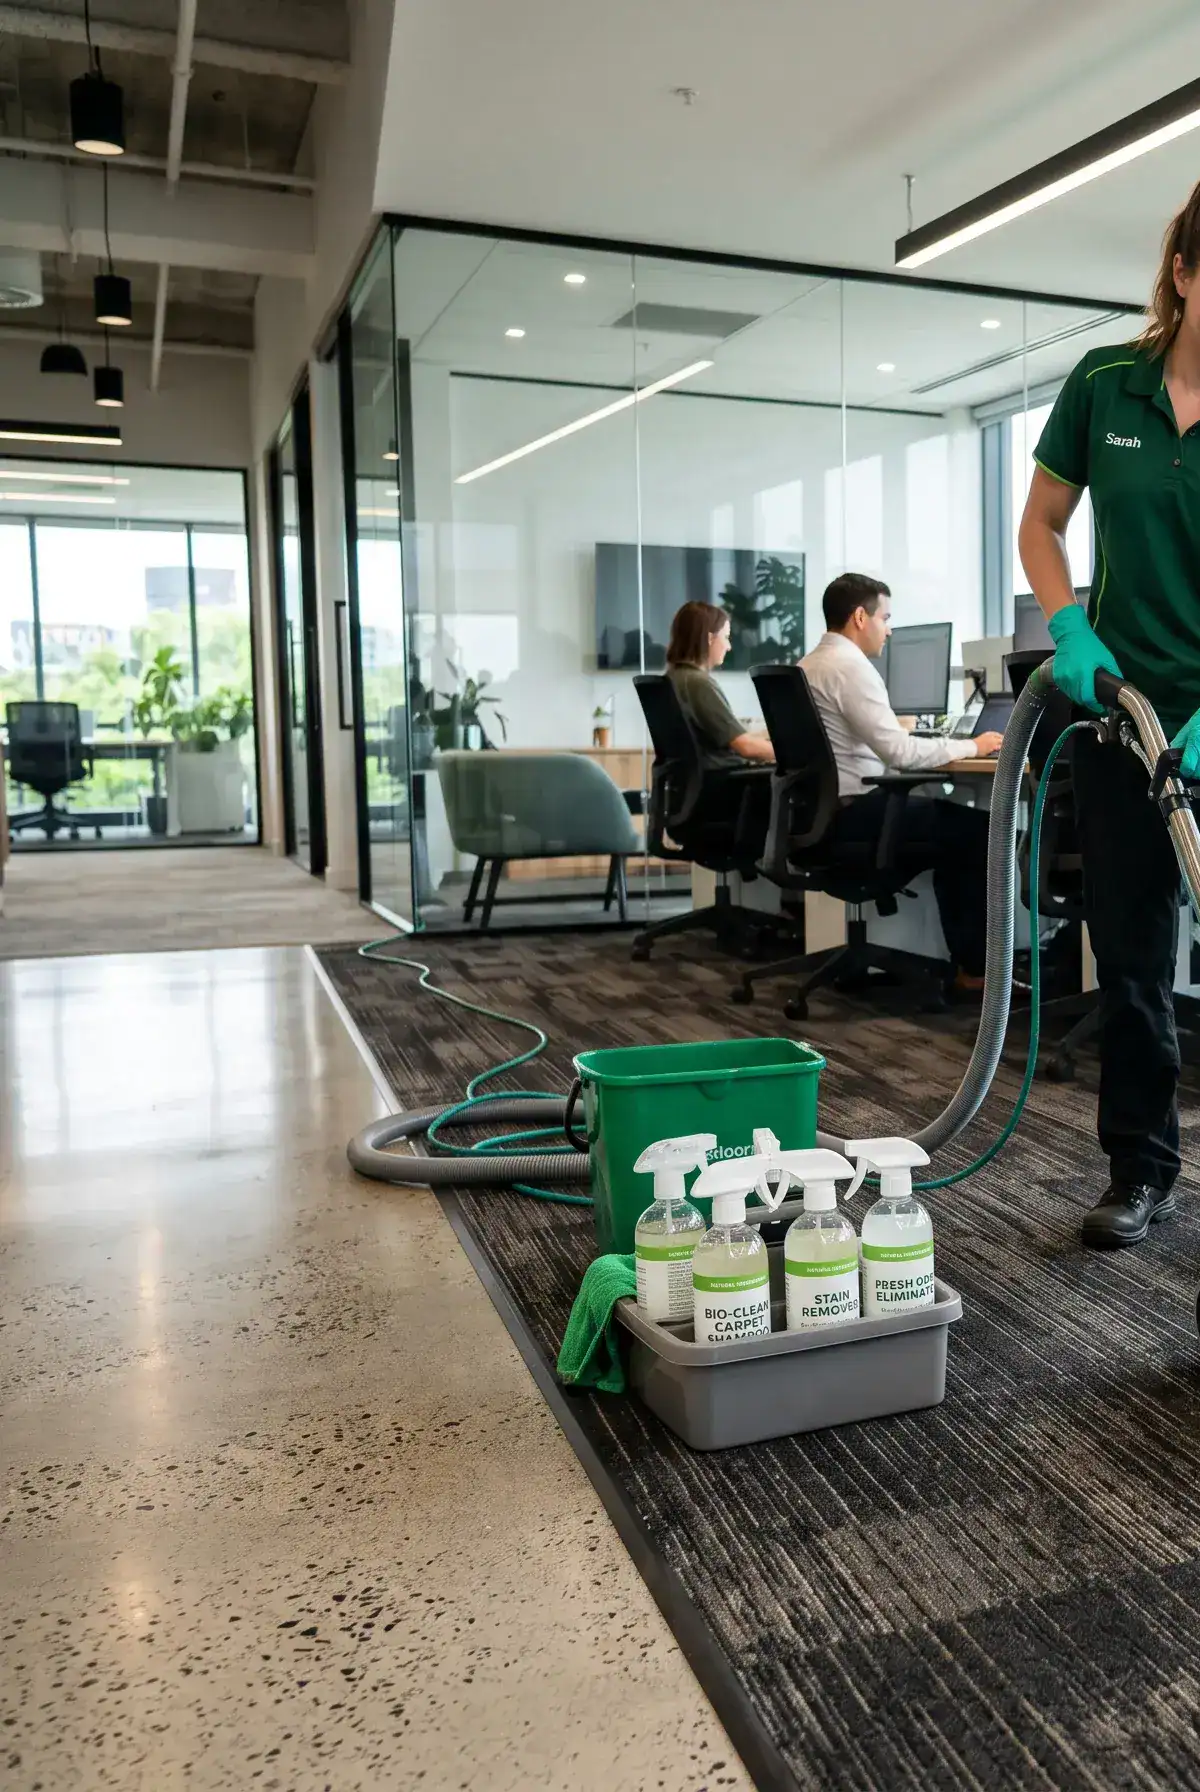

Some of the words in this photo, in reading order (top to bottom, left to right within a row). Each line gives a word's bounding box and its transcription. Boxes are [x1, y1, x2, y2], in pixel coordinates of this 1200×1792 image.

[1105, 432, 1142, 449] Sarah
[814, 1289, 850, 1305] STAIN
[705, 1299, 769, 1319] BIO-CLEAN
[715, 1314, 764, 1332] CARPET
